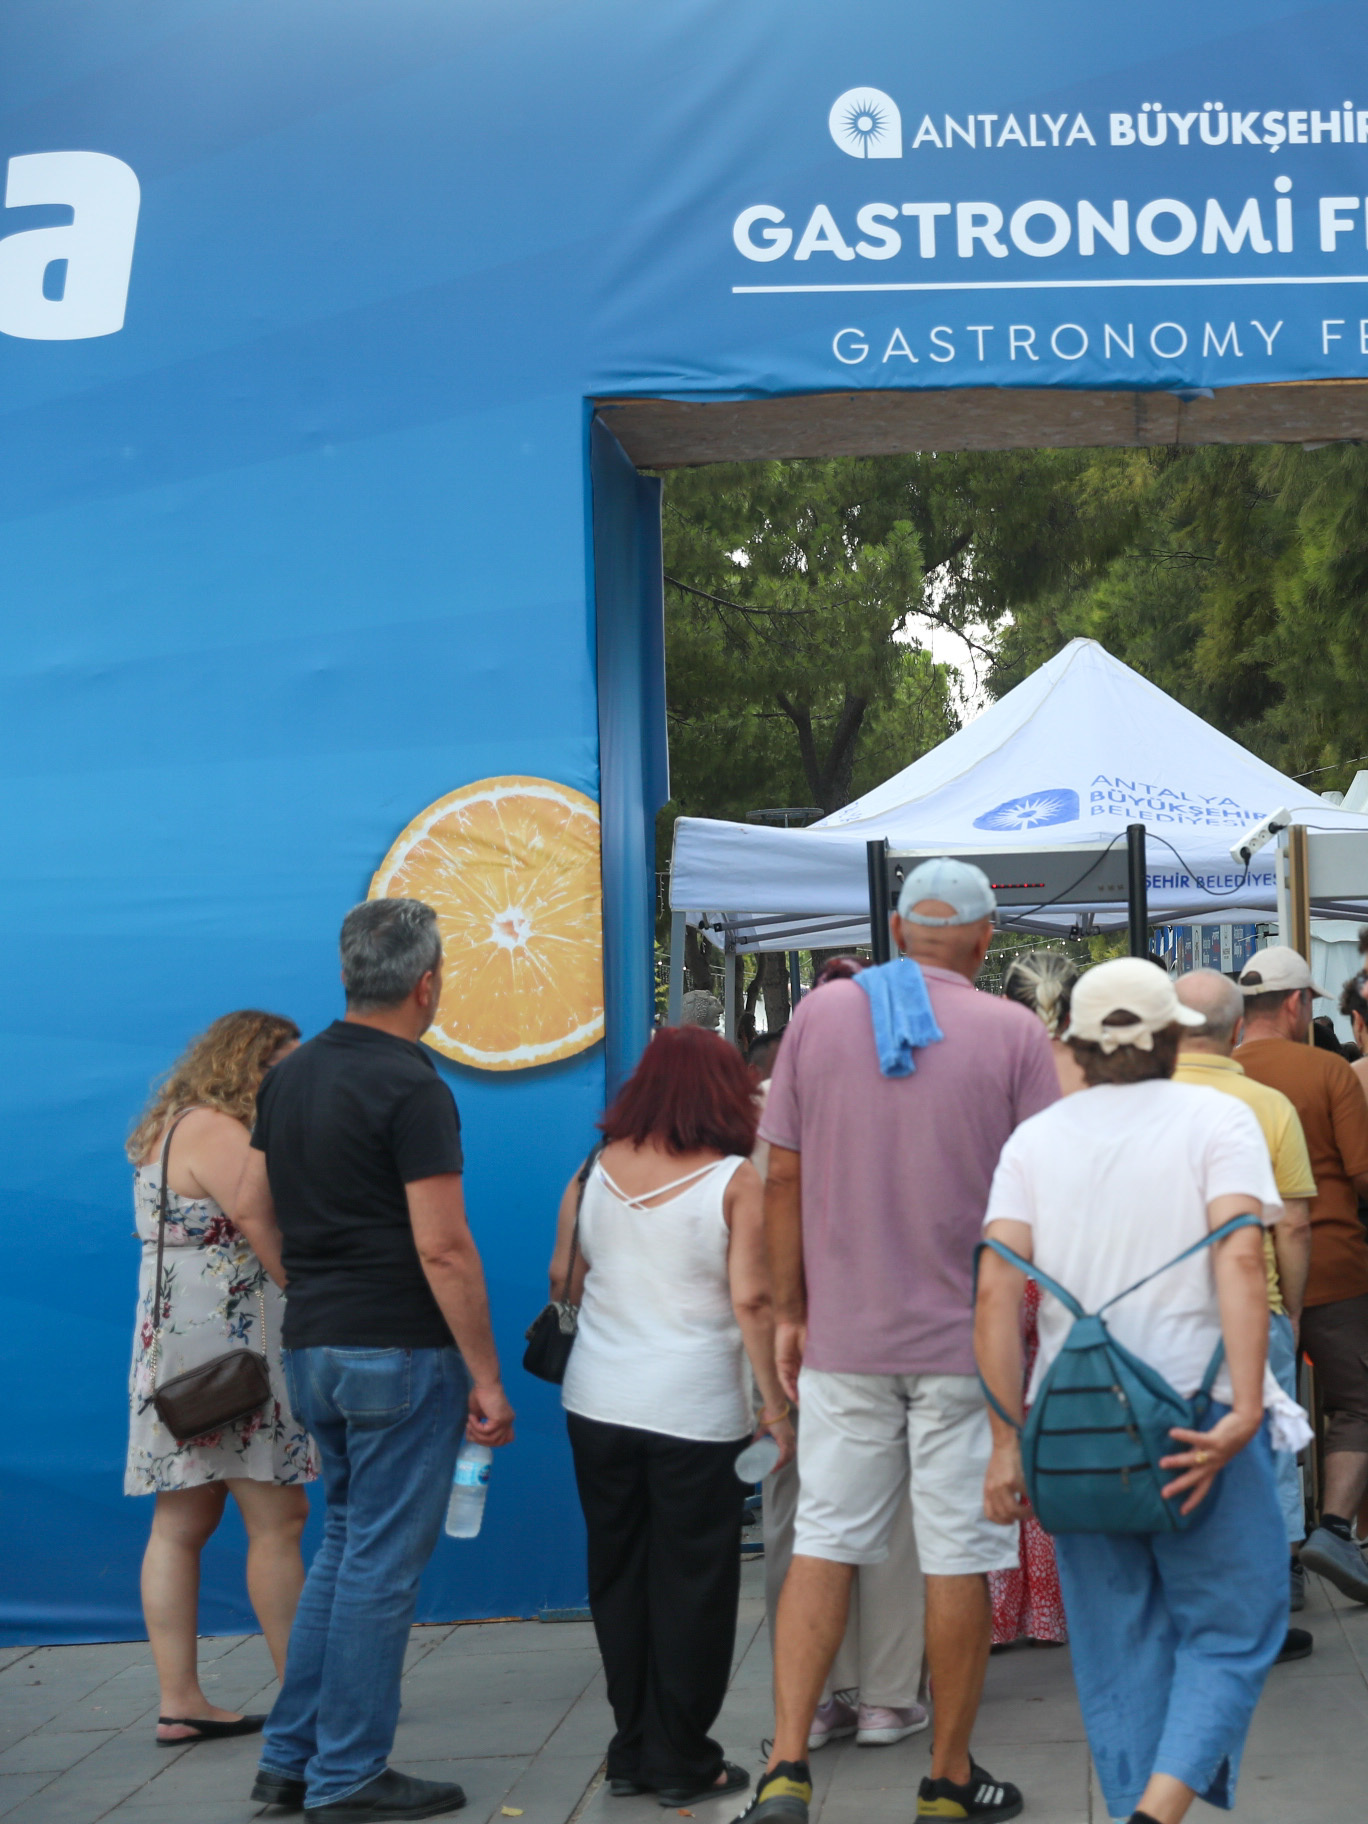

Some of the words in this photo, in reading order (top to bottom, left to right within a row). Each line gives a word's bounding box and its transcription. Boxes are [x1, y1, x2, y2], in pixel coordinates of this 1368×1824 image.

[912, 112, 1096, 148] ANTALYA
[732, 175, 1293, 262] GASTRONOMİ
[832, 320, 1283, 364] GASTRONOMY
[1090, 775, 1240, 808] ANTALYA
[1090, 789, 1267, 820] BÜYÜKŞEHİR
[1091, 804, 1246, 827] BELEDİYESİ
